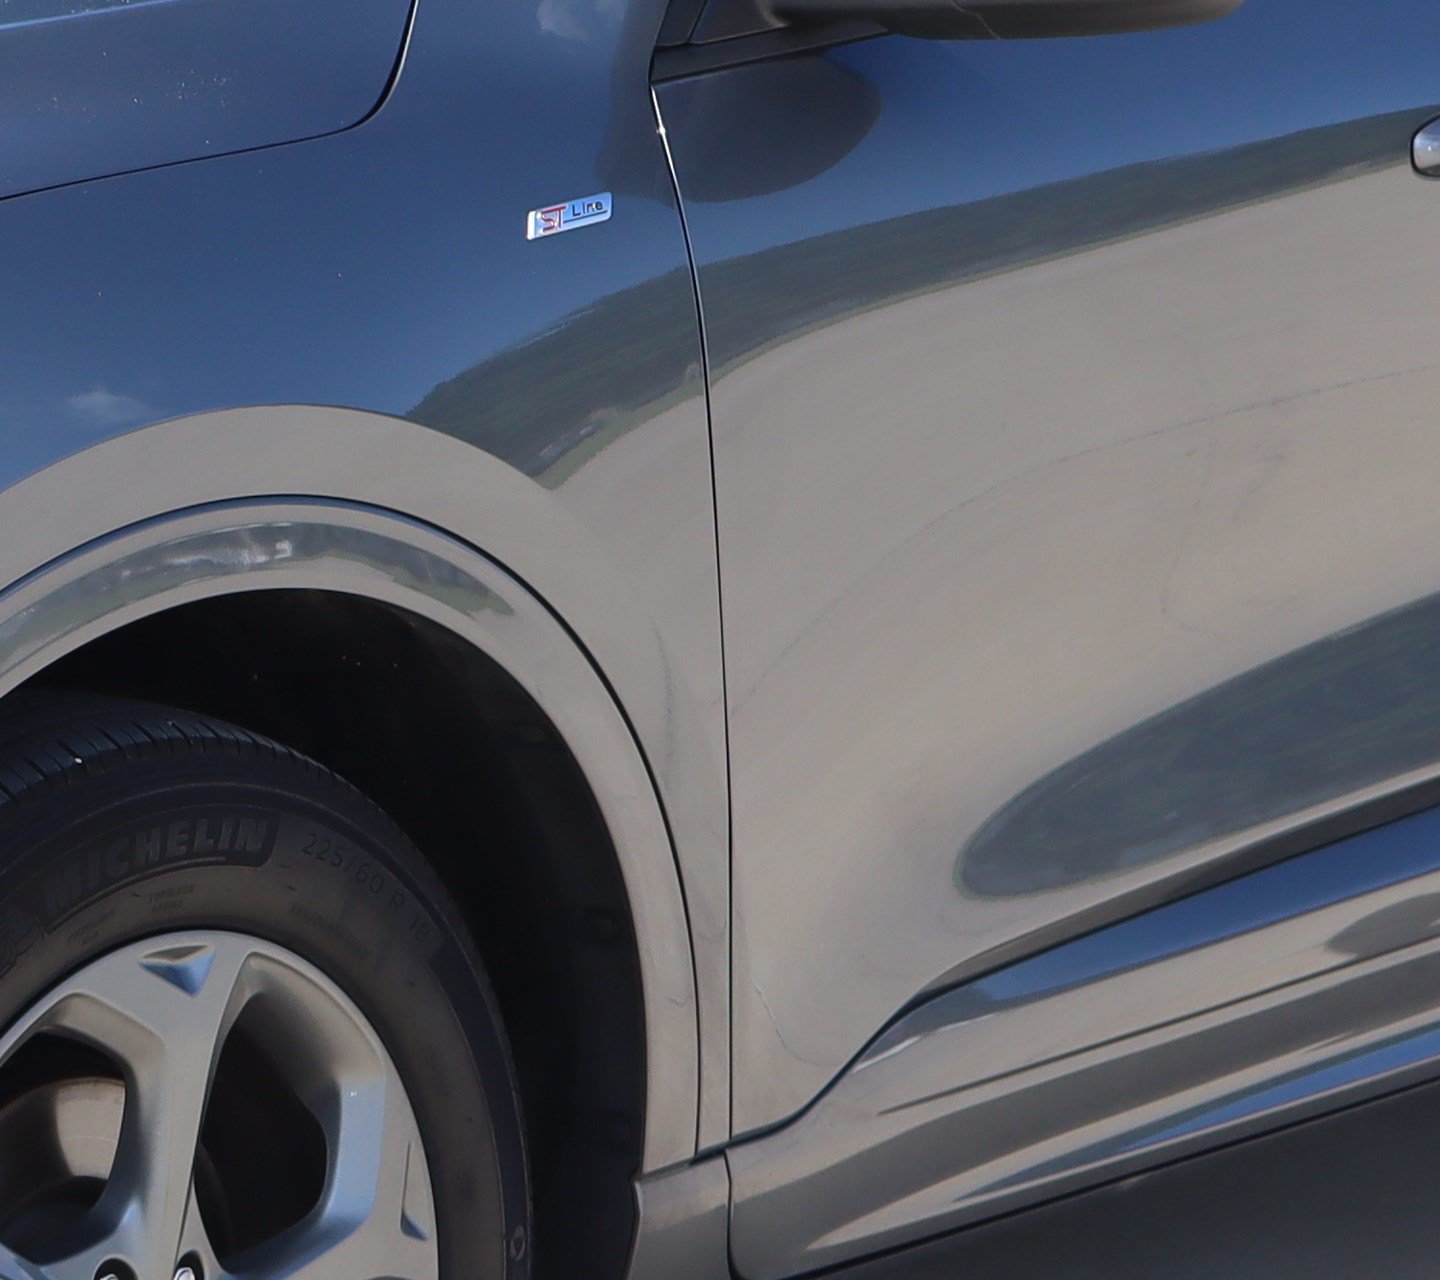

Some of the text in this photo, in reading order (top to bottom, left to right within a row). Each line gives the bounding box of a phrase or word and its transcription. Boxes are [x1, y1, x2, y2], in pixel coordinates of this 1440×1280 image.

[538, 204, 568, 234] ST
[42, 815, 270, 919] MICHELIN
[301, 831, 386, 895] 225/60
